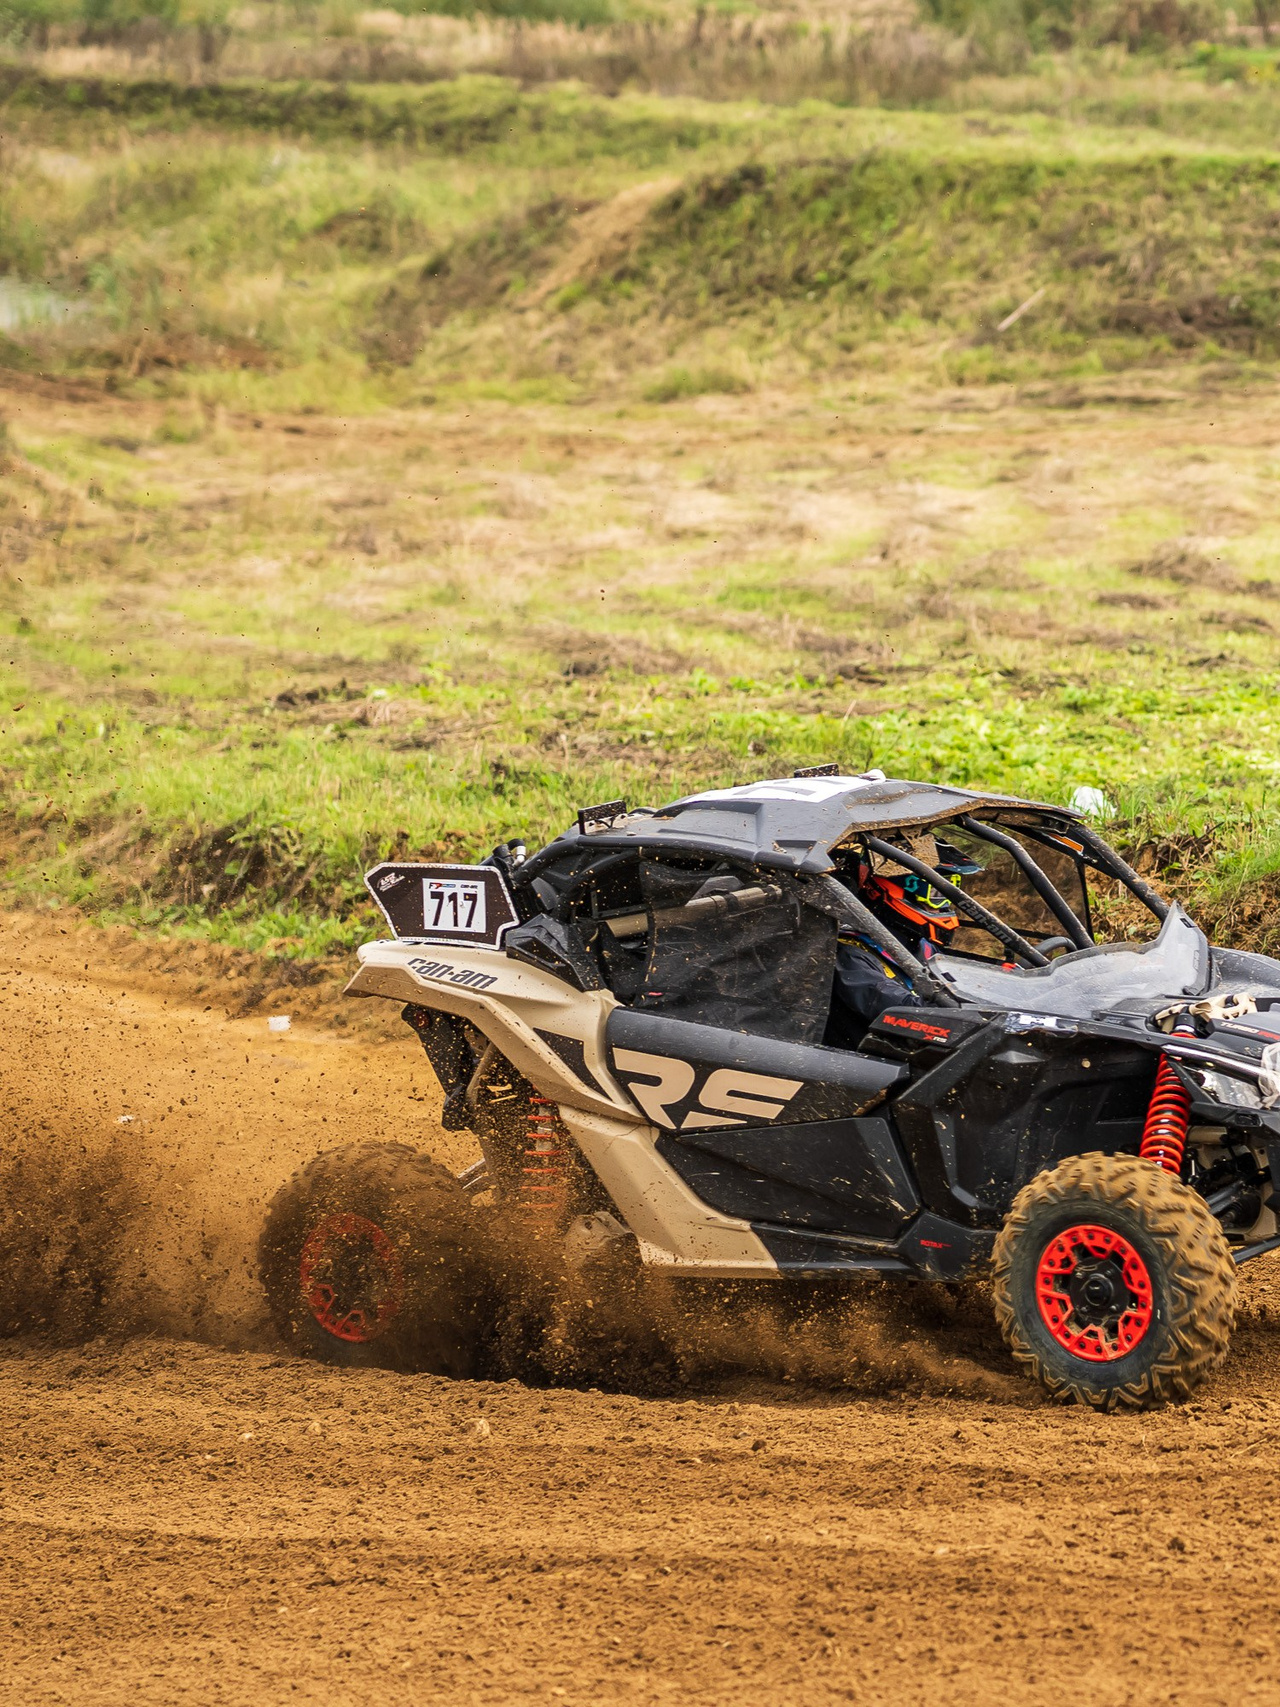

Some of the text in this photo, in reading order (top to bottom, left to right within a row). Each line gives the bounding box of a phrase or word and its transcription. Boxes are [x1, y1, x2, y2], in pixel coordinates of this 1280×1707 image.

[430, 890, 478, 928] 717
[407, 958, 498, 989] can-am
[882, 1015, 951, 1038] MAVERICK
[1220, 1021, 1260, 1034] TURBO
[612, 1047, 804, 1130] RS
